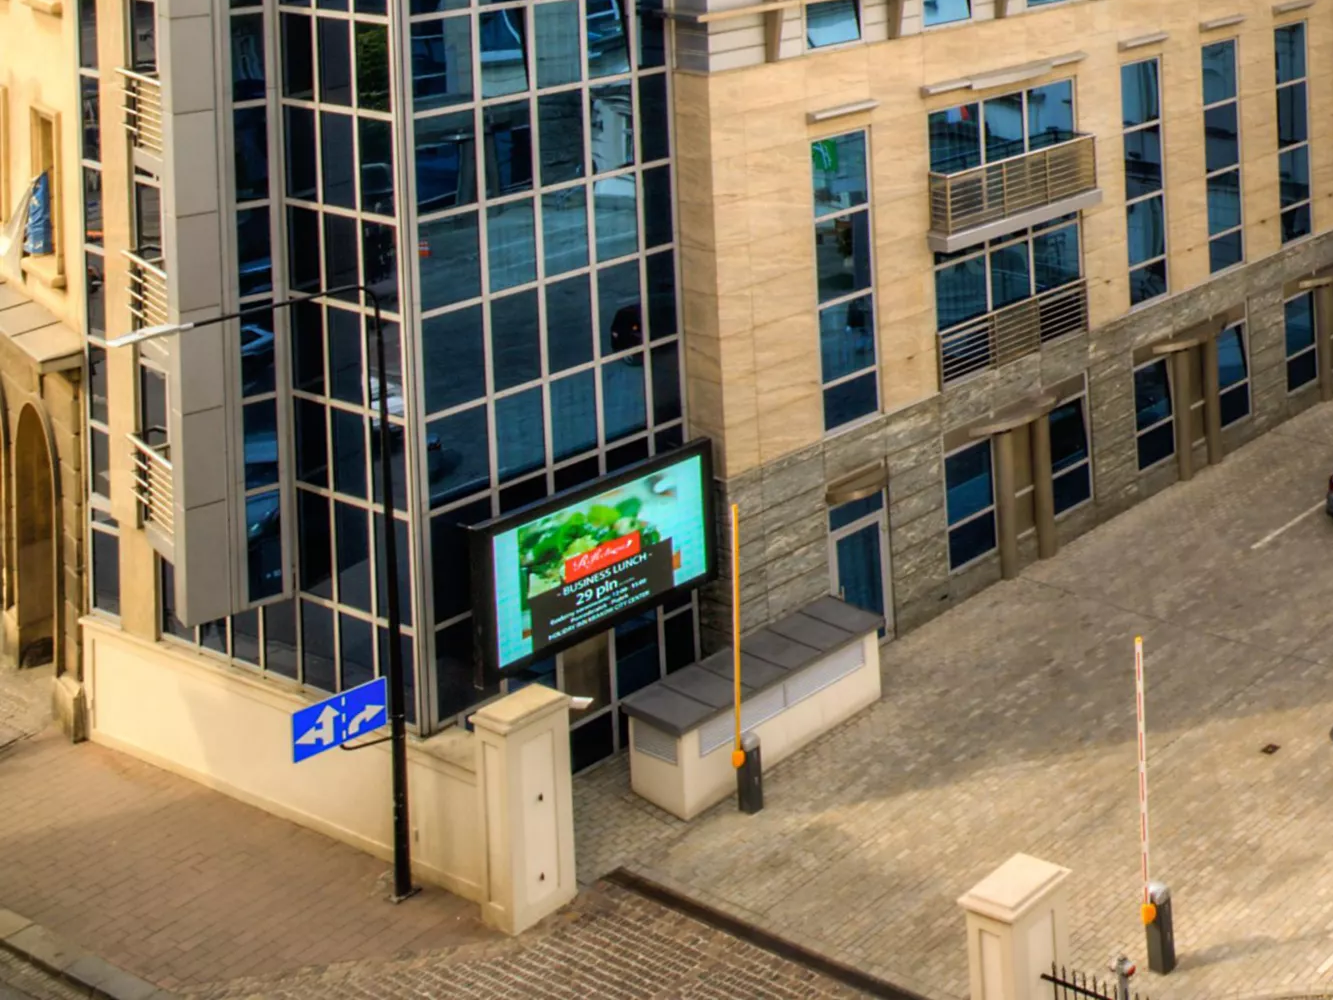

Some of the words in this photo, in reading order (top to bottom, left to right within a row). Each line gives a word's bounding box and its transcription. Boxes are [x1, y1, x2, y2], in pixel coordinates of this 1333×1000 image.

[563, 567, 611, 596] BUSINESS
[613, 552, 647, 575] LUNCH
[576, 589, 593, 606] 29
[596, 579, 619, 599] pln
